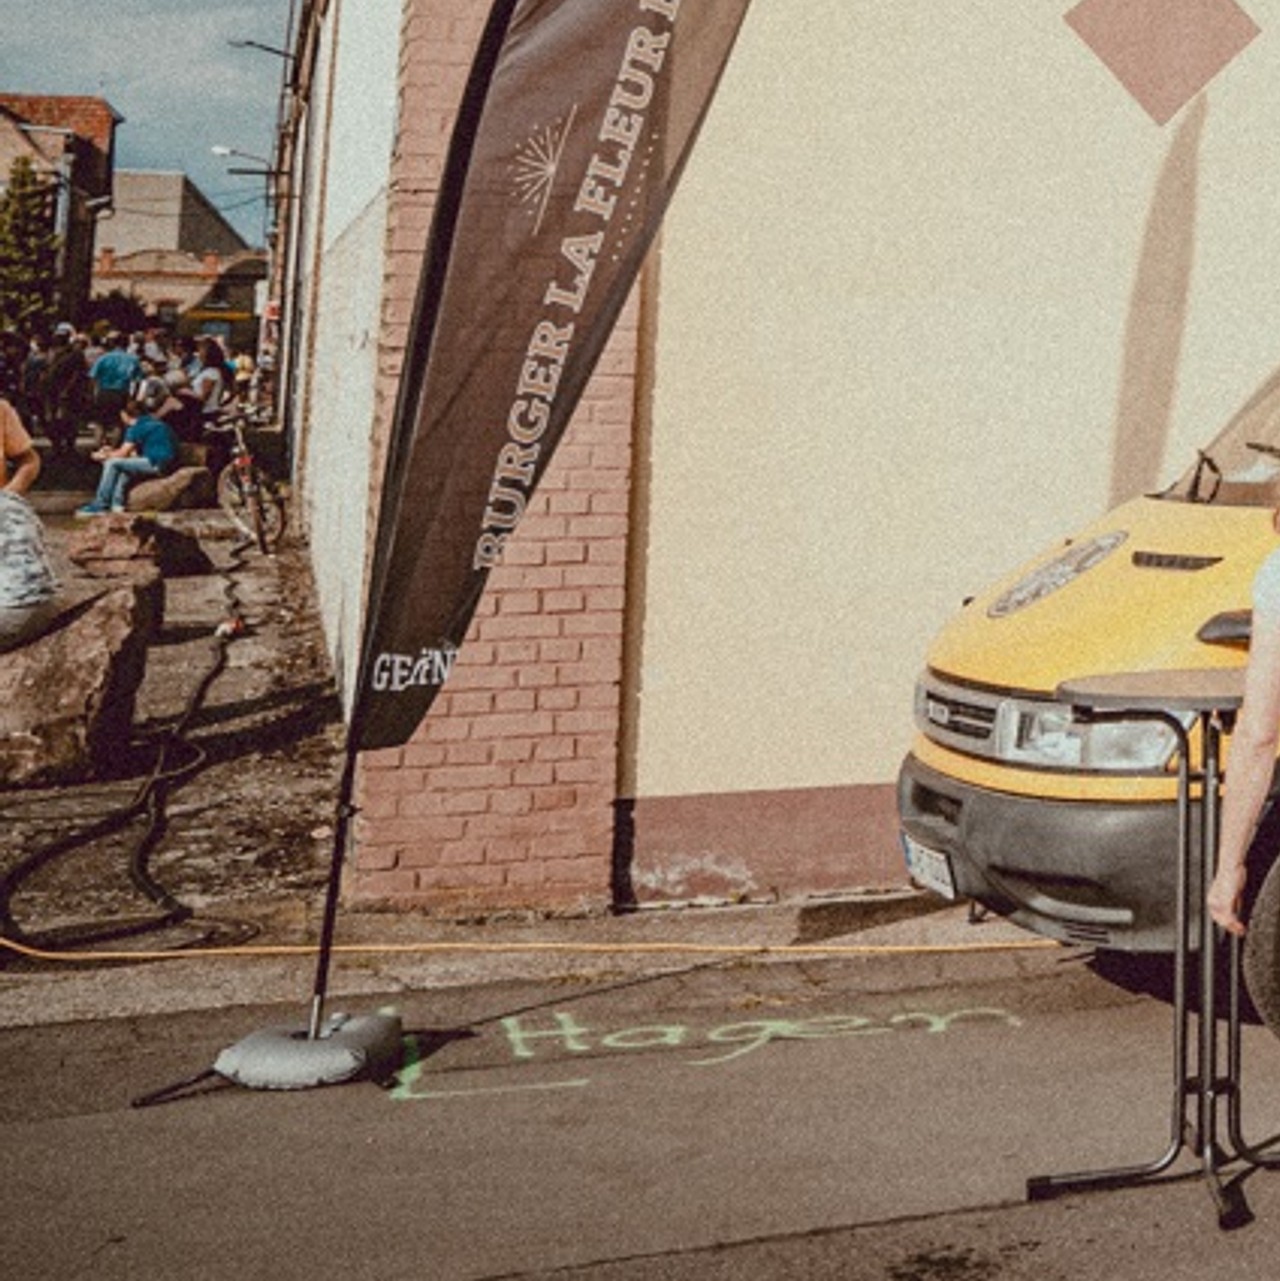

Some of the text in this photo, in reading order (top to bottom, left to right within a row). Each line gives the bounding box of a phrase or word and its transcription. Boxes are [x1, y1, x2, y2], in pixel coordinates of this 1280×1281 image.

[573, 25, 672, 221] FLEUR
[544, 231, 605, 314] LA
[473, 320, 575, 571] BURGER
